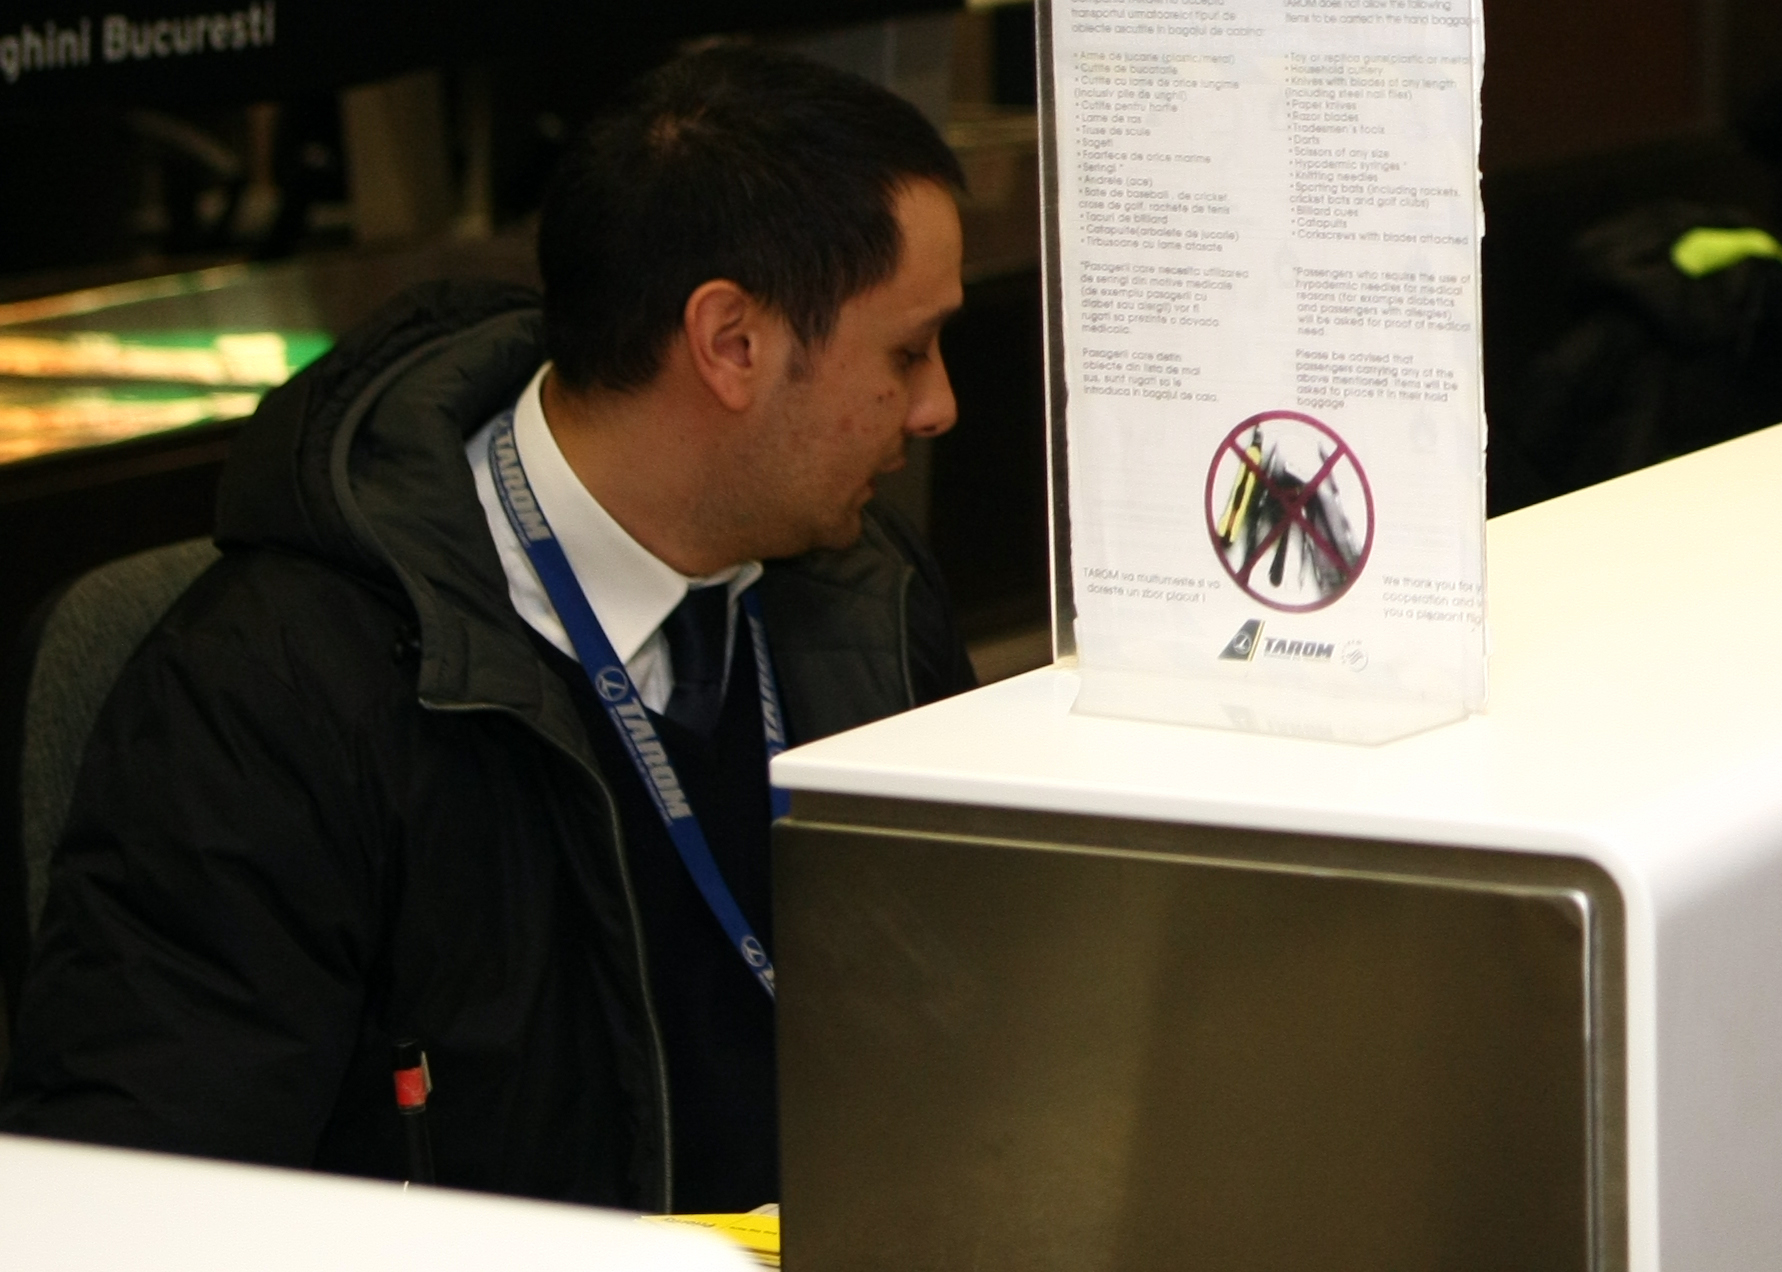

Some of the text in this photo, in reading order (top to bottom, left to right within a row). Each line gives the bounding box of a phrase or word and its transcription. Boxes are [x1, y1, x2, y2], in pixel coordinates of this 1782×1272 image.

[1292, 99, 1320, 112] Paper
[1082, 114, 1142, 125] Lame de ras
[1292, 111, 1359, 123] Razor blades
[1109, 127, 1124, 137] de
[1293, 135, 1319, 146] Darts
[1130, 152, 1144, 163] de
[1334, 148, 1346, 158] of
[1341, 183, 1364, 194] bats
[1353, 196, 1375, 207] and
[1118, 213, 1132, 224] de
[1185, 227, 1199, 238] de
[1331, 350, 1345, 361] be
[1422, 367, 1433, 378] of
[495, 429, 553, 541] TAROM
[1382, 575, 1400, 587] We
[1436, 579, 1456, 592] you
[1126, 587, 1140, 597] un
[1382, 593, 1474, 609] cooperation and
[1382, 607, 1404, 620] you
[1406, 611, 1414, 620] a
[1264, 636, 1336, 660] TAROM
[623, 698, 692, 819] TAROM
